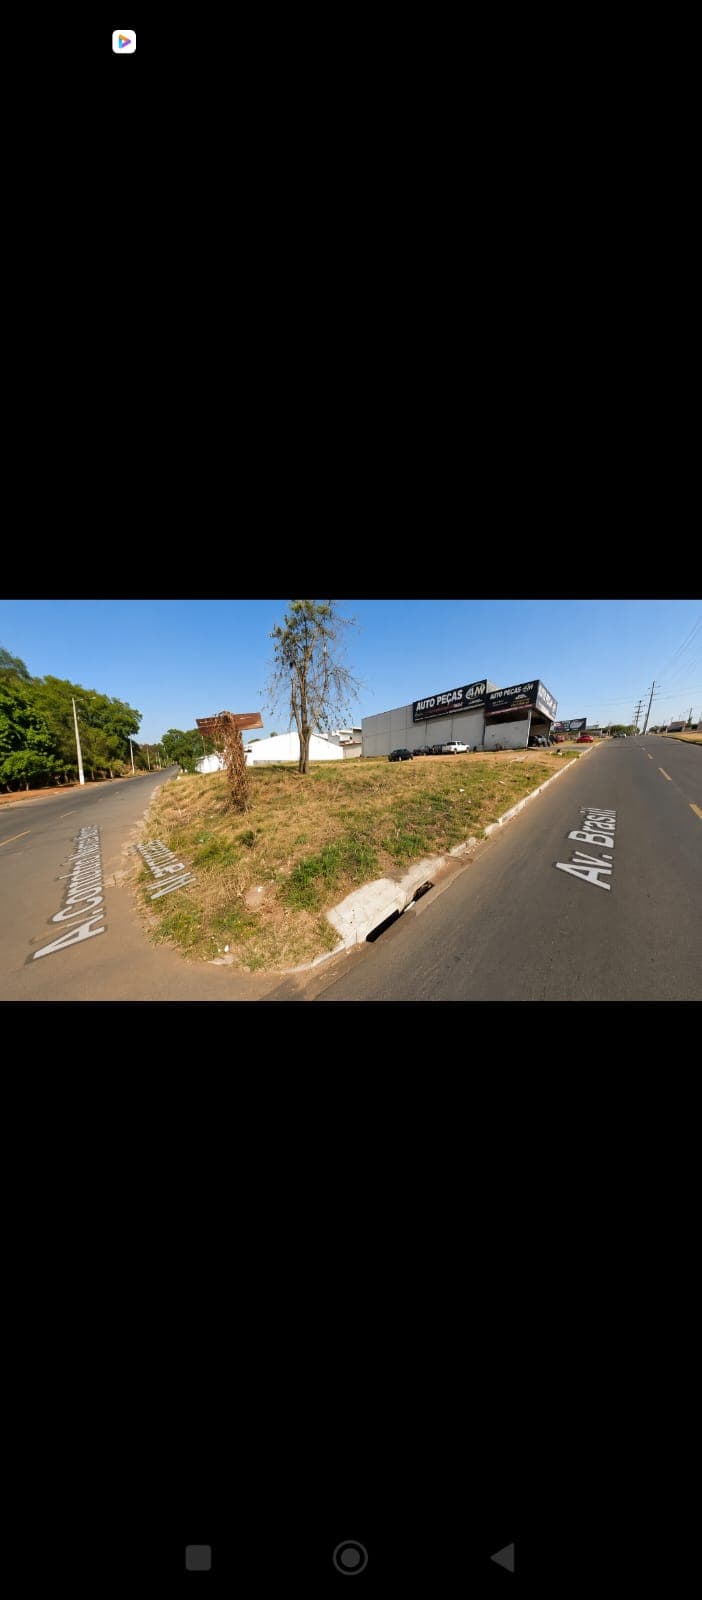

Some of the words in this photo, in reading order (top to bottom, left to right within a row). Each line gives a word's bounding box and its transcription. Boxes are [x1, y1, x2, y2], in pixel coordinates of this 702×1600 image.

[416, 698, 435, 711] AUTO
[436, 690, 463, 705] PEÇAS
[490, 691, 503, 700] AUTO
